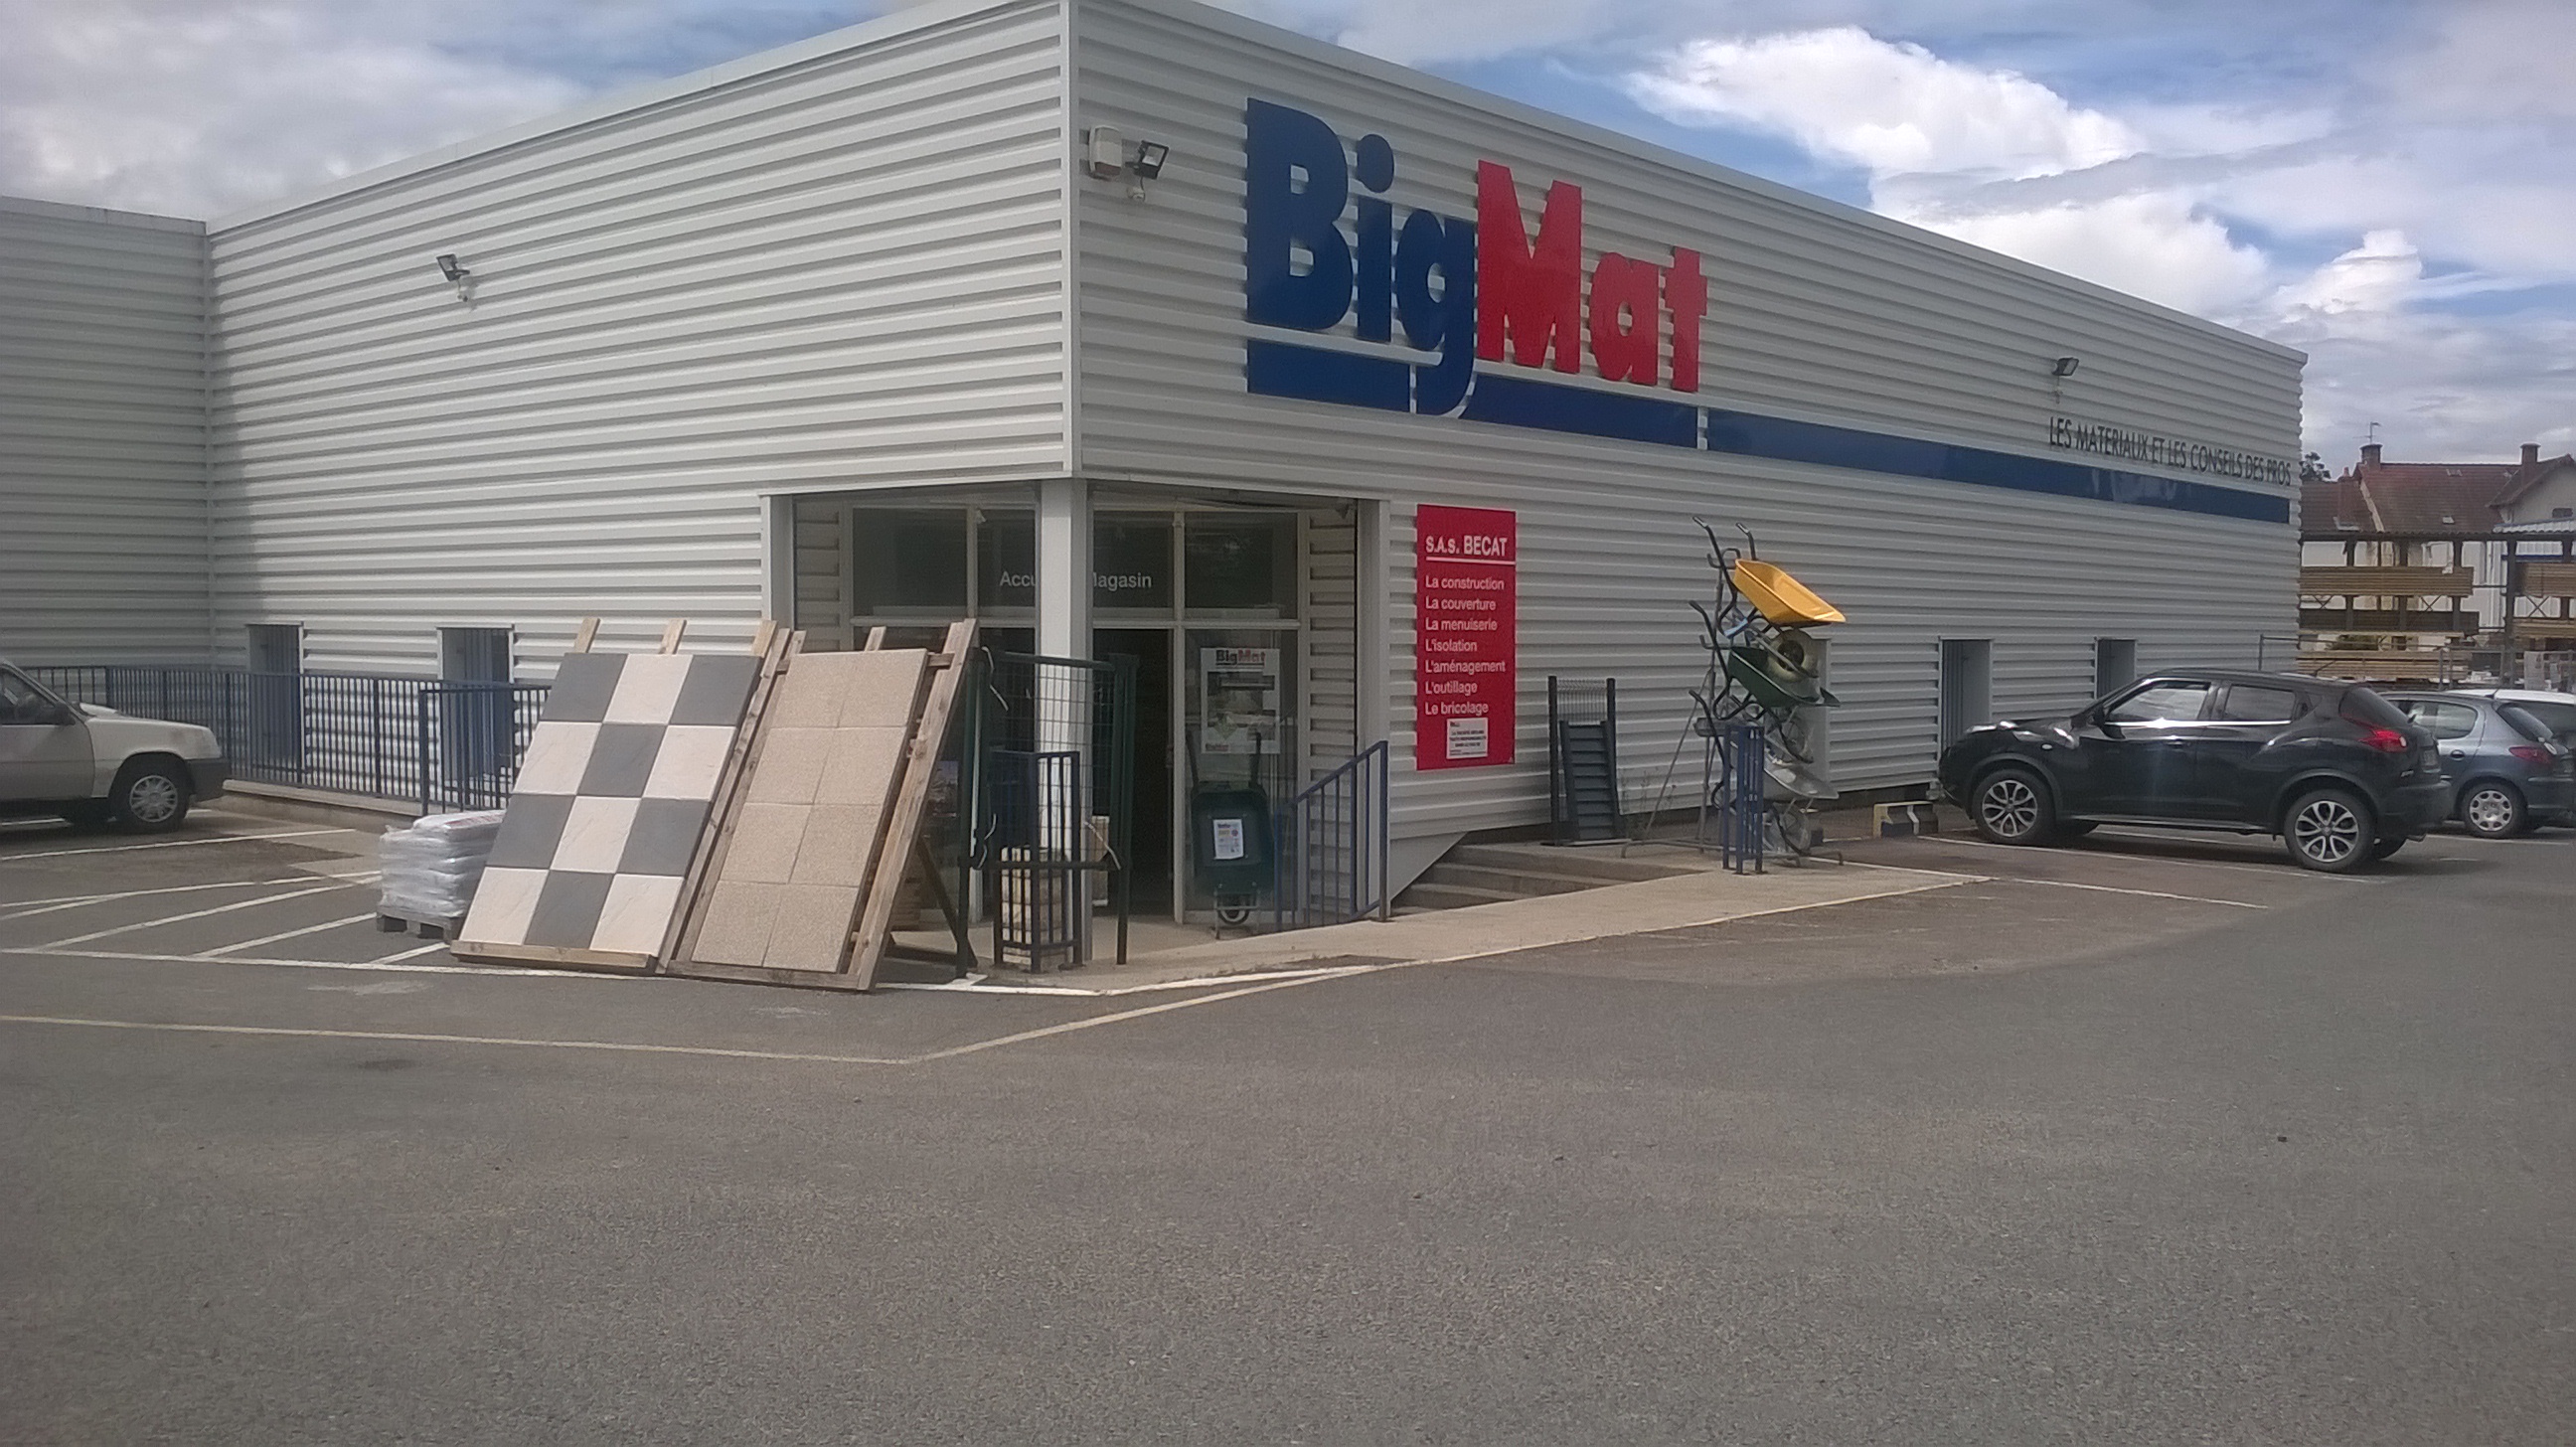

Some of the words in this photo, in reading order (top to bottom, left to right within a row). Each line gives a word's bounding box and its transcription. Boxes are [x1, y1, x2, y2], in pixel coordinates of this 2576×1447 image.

[1247, 97, 1707, 415] BigMat
[2049, 416, 2073, 448] LES
[2075, 423, 2149, 462] MATERIAUX
[2152, 436, 2165, 464] ET
[2168, 438, 2186, 469] LES
[2189, 444, 2243, 478] CONSEILS
[2245, 454, 2264, 482] DES
[2267, 459, 2291, 486] PROS
[1463, 535, 1508, 557] BECAT
[1425, 575, 1439, 588] La
[1441, 577, 1505, 590] construction
[1425, 596, 1439, 609] La
[1441, 598, 1496, 610] couverture
[1425, 617, 1439, 631] La
[1441, 618, 1498, 631] menuiserie
[1425, 638, 1478, 652] L'isolation
[1425, 659, 1506, 675] L'aménagement
[1425, 681, 1478, 697] L'outillage
[1425, 702, 1439, 716] Le
[1441, 701, 1489, 717] bricolage
